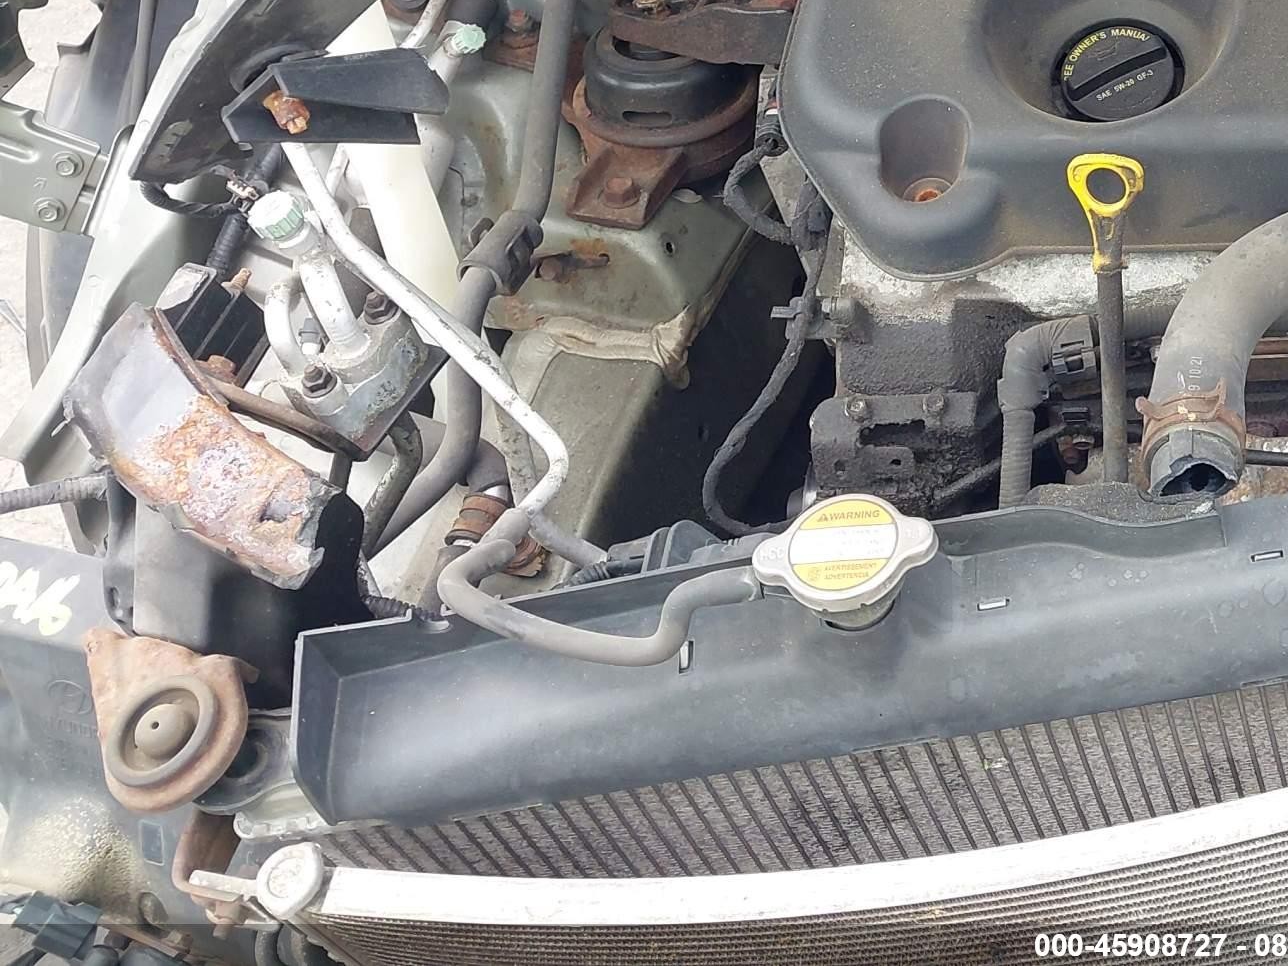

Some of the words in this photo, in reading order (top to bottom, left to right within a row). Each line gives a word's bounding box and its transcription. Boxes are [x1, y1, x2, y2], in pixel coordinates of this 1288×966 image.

[1069, 32, 1107, 62] OWNER'S
[1096, 89, 1113, 101] SAE
[830, 509, 880, 522] WARNING
